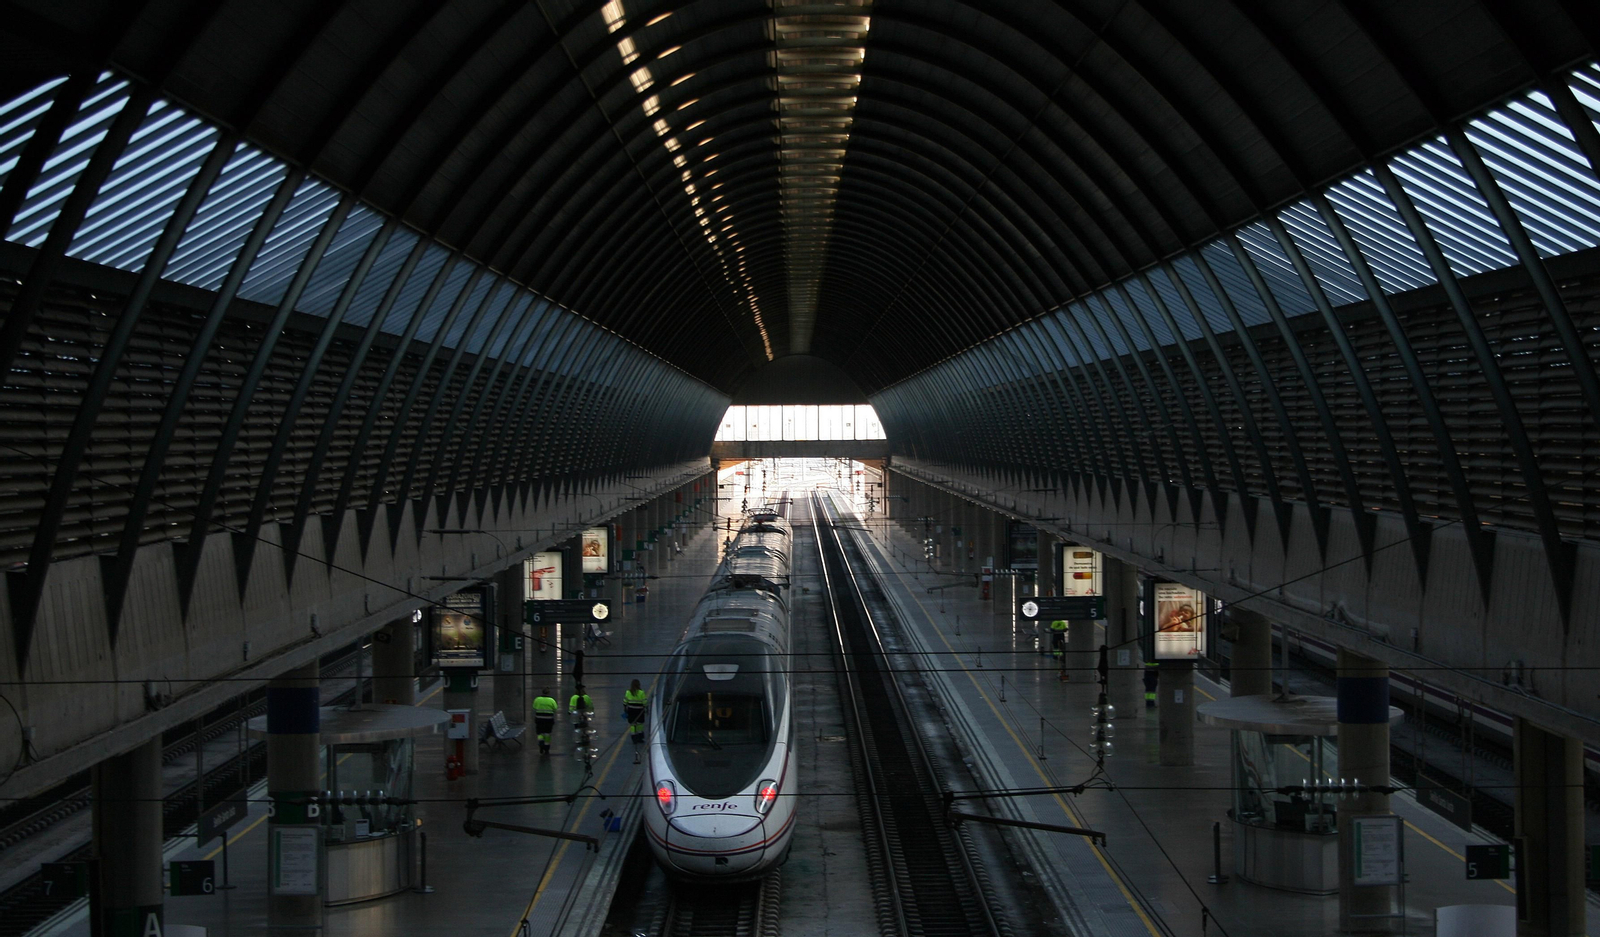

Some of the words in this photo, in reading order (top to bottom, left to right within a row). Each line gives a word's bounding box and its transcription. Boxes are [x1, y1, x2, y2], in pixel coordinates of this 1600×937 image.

[533, 612, 541, 622] 6
[1090, 608, 1097, 618] 5
[514, 637, 522, 649] E
[692, 801, 738, 812] renfe
[1468, 862, 1478, 878] 5
[43, 880, 53, 896] 7
[202, 877, 213, 893] 6
[143, 913, 162, 937] A
